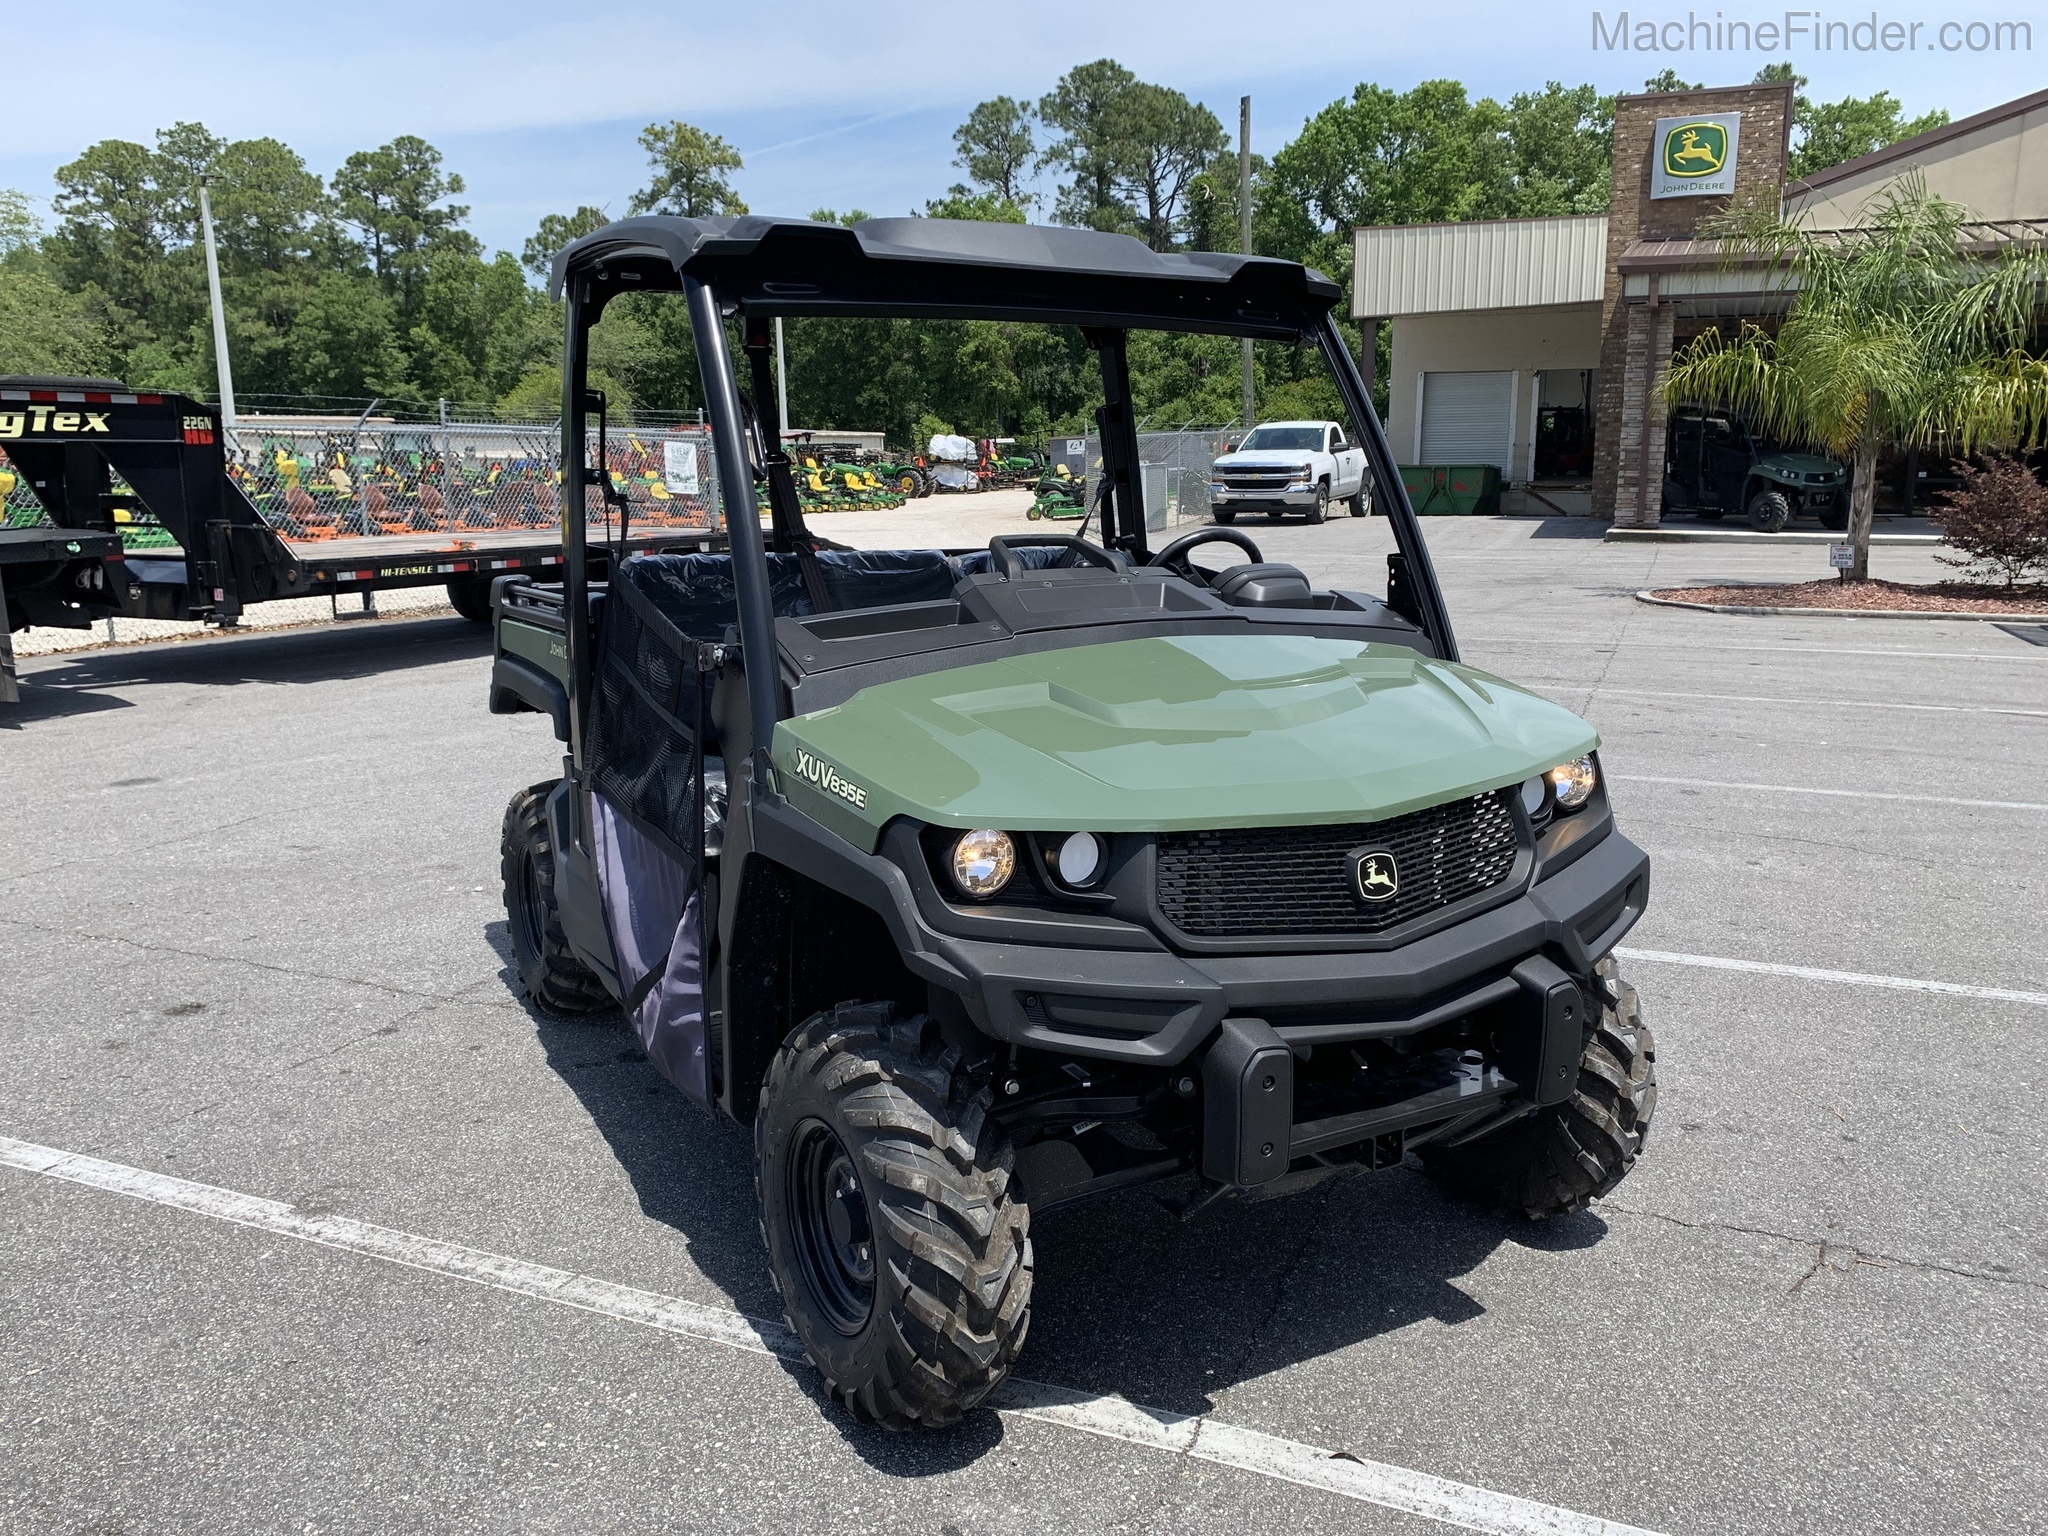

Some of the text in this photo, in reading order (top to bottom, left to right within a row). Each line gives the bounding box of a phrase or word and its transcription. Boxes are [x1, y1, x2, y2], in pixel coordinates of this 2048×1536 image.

[1660, 182, 1725, 194] JOHN DEERE
[184, 430, 214, 445] HD
[380, 565, 434, 577] HI-TENSILE
[550, 640, 564, 659] JOHN
